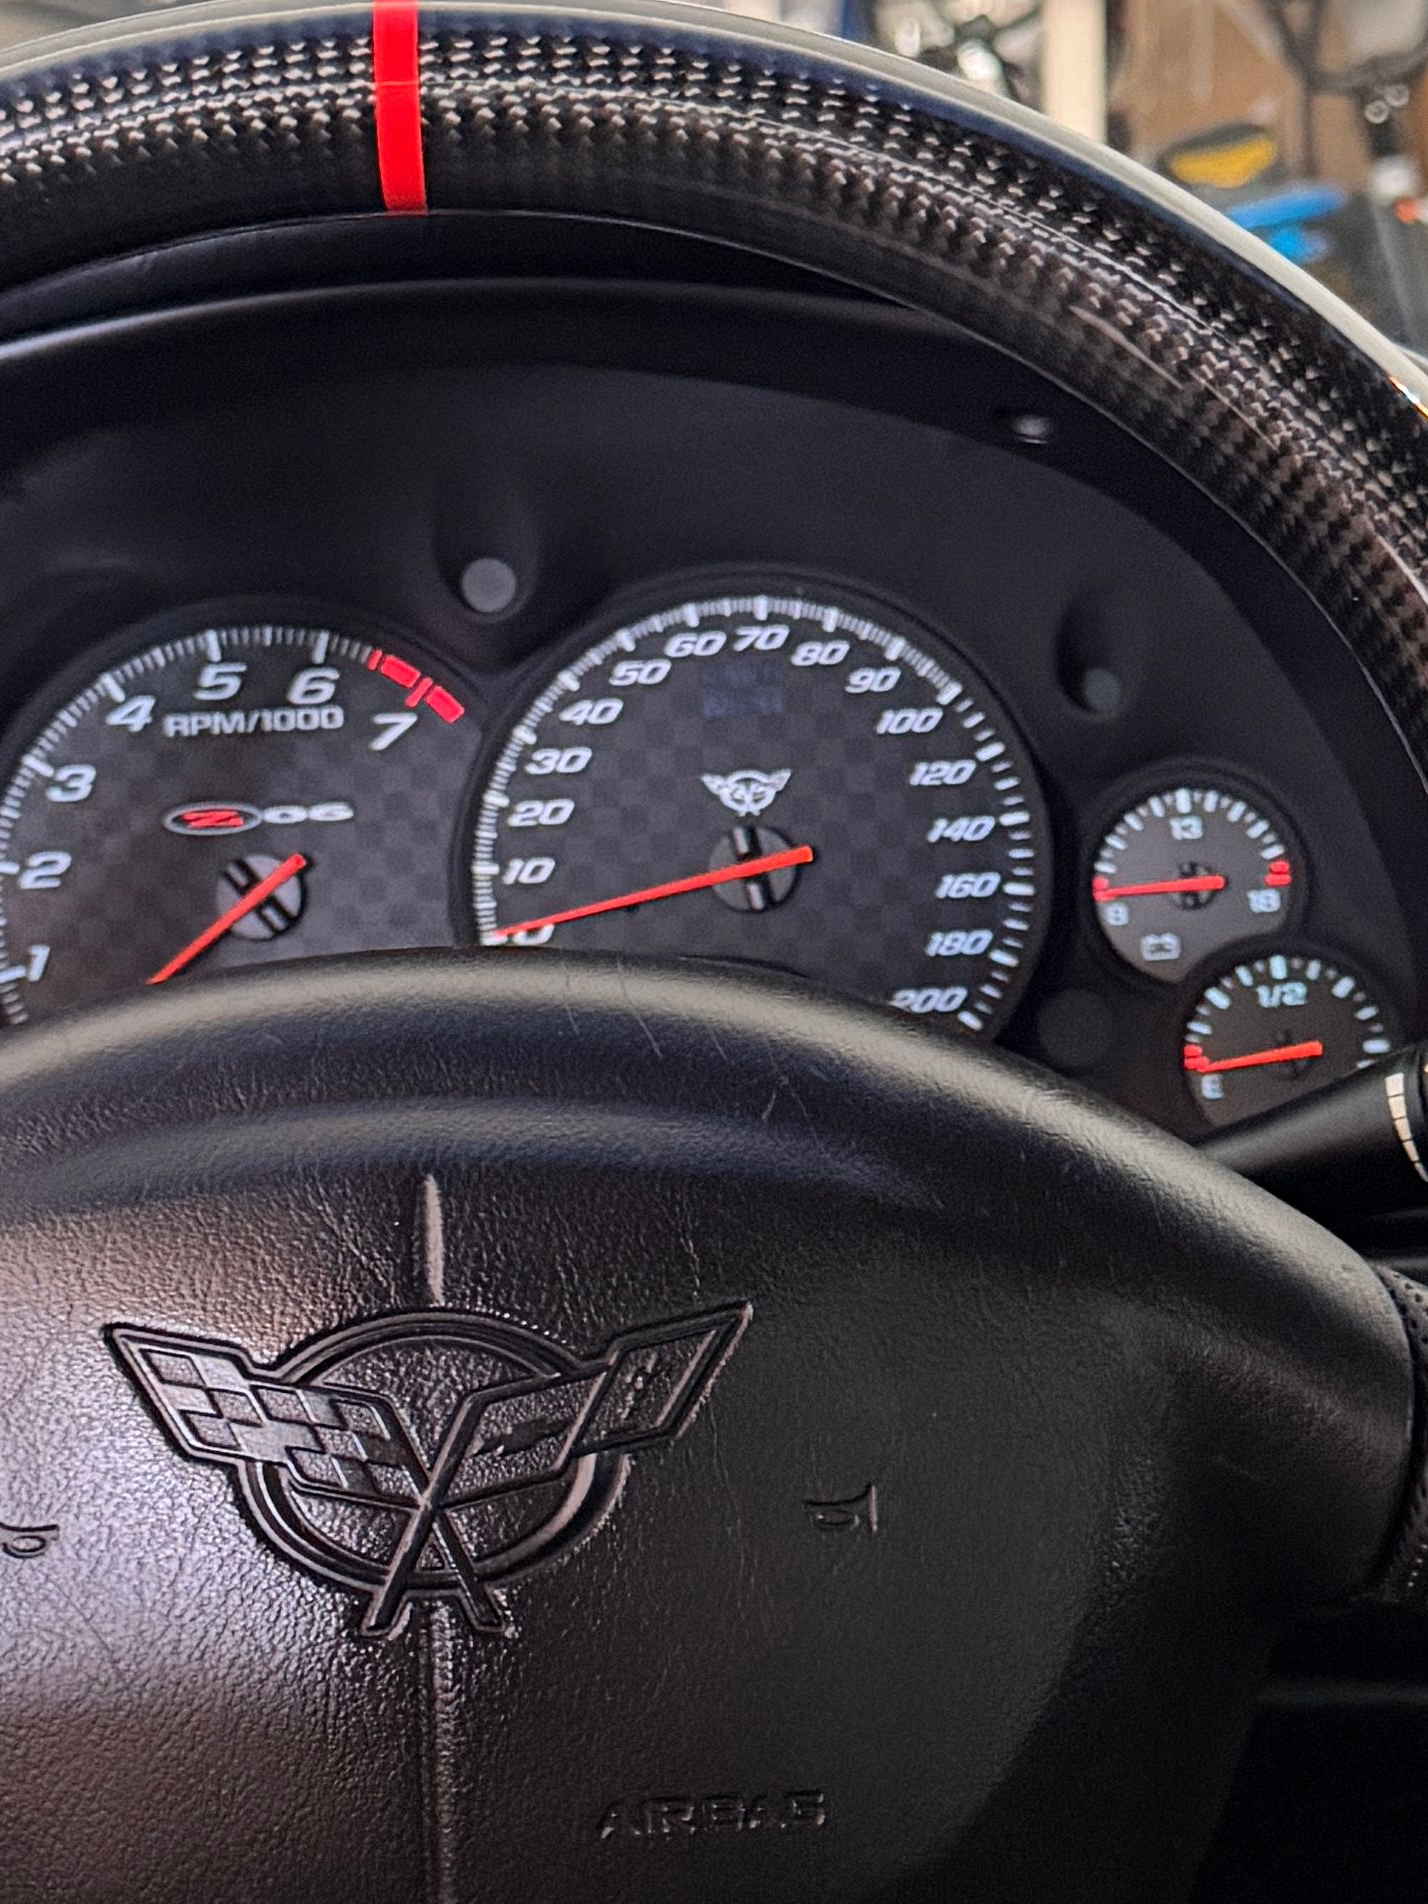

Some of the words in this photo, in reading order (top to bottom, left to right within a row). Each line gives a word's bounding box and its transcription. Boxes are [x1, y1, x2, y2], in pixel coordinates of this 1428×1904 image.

[664, 631, 727, 658] 60
[733, 624, 790, 651] 70
[791, 640, 851, 666] 80
[194, 663, 247, 700] 5
[609, 659, 672, 686] 50
[844, 667, 902, 694] 90
[288, 668, 340, 705] 6
[106, 696, 155, 731] 4
[164, 704, 344, 736] RPM/1000
[559, 698, 624, 725] 40
[875, 708, 944, 734] 100
[370, 713, 417, 750] 7
[525, 749, 593, 775] 30
[908, 760, 977, 786] 120
[46, 764, 97, 802] 3
[507, 799, 575, 827] 20
[927, 816, 996, 843] 140
[19, 851, 71, 889] 2
[503, 857, 556, 885] 10
[935, 872, 1001, 899] 160
[924, 930, 994, 957] 180
[25, 944, 50, 982] 1
[889, 986, 968, 1014] 200
